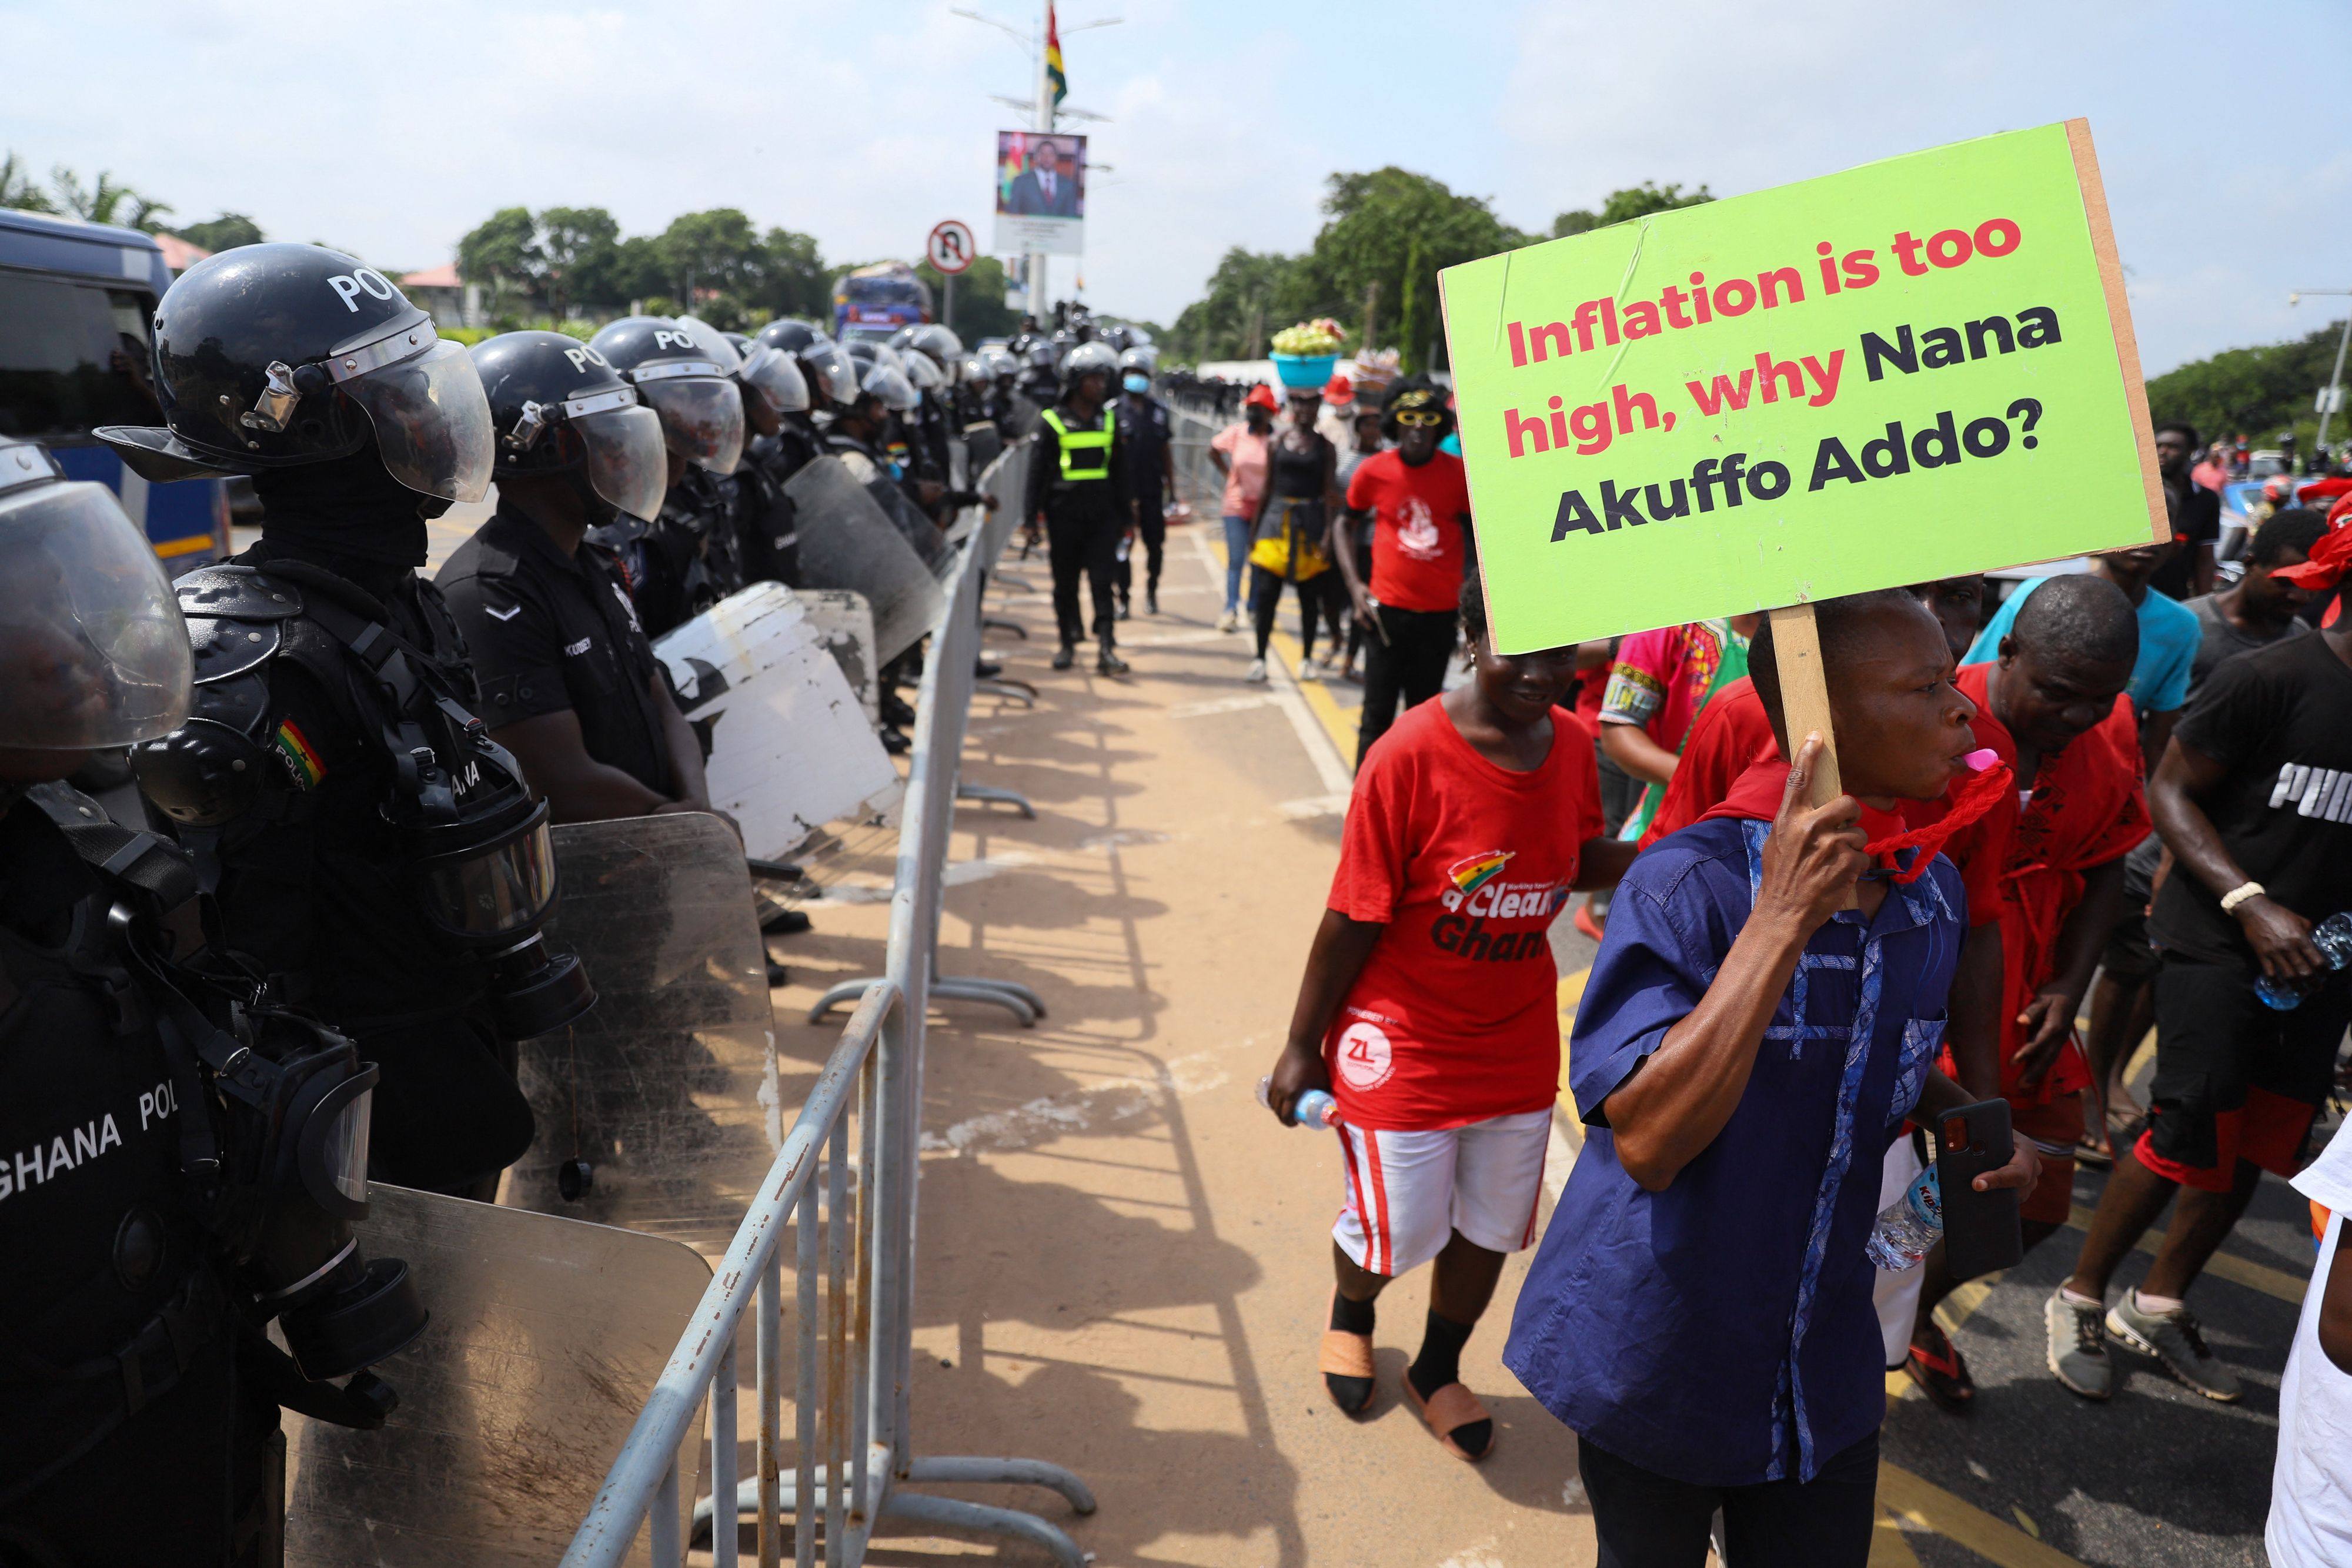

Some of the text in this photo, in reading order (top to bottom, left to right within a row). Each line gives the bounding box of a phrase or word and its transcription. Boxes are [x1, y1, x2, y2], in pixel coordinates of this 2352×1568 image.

[1507, 218, 2022, 367] Inflation is too
[1504, 306, 2062, 458] high, why Nana
[1550, 397, 2043, 543] Akuffo Addo?
[1442, 888, 1464, 912] a
